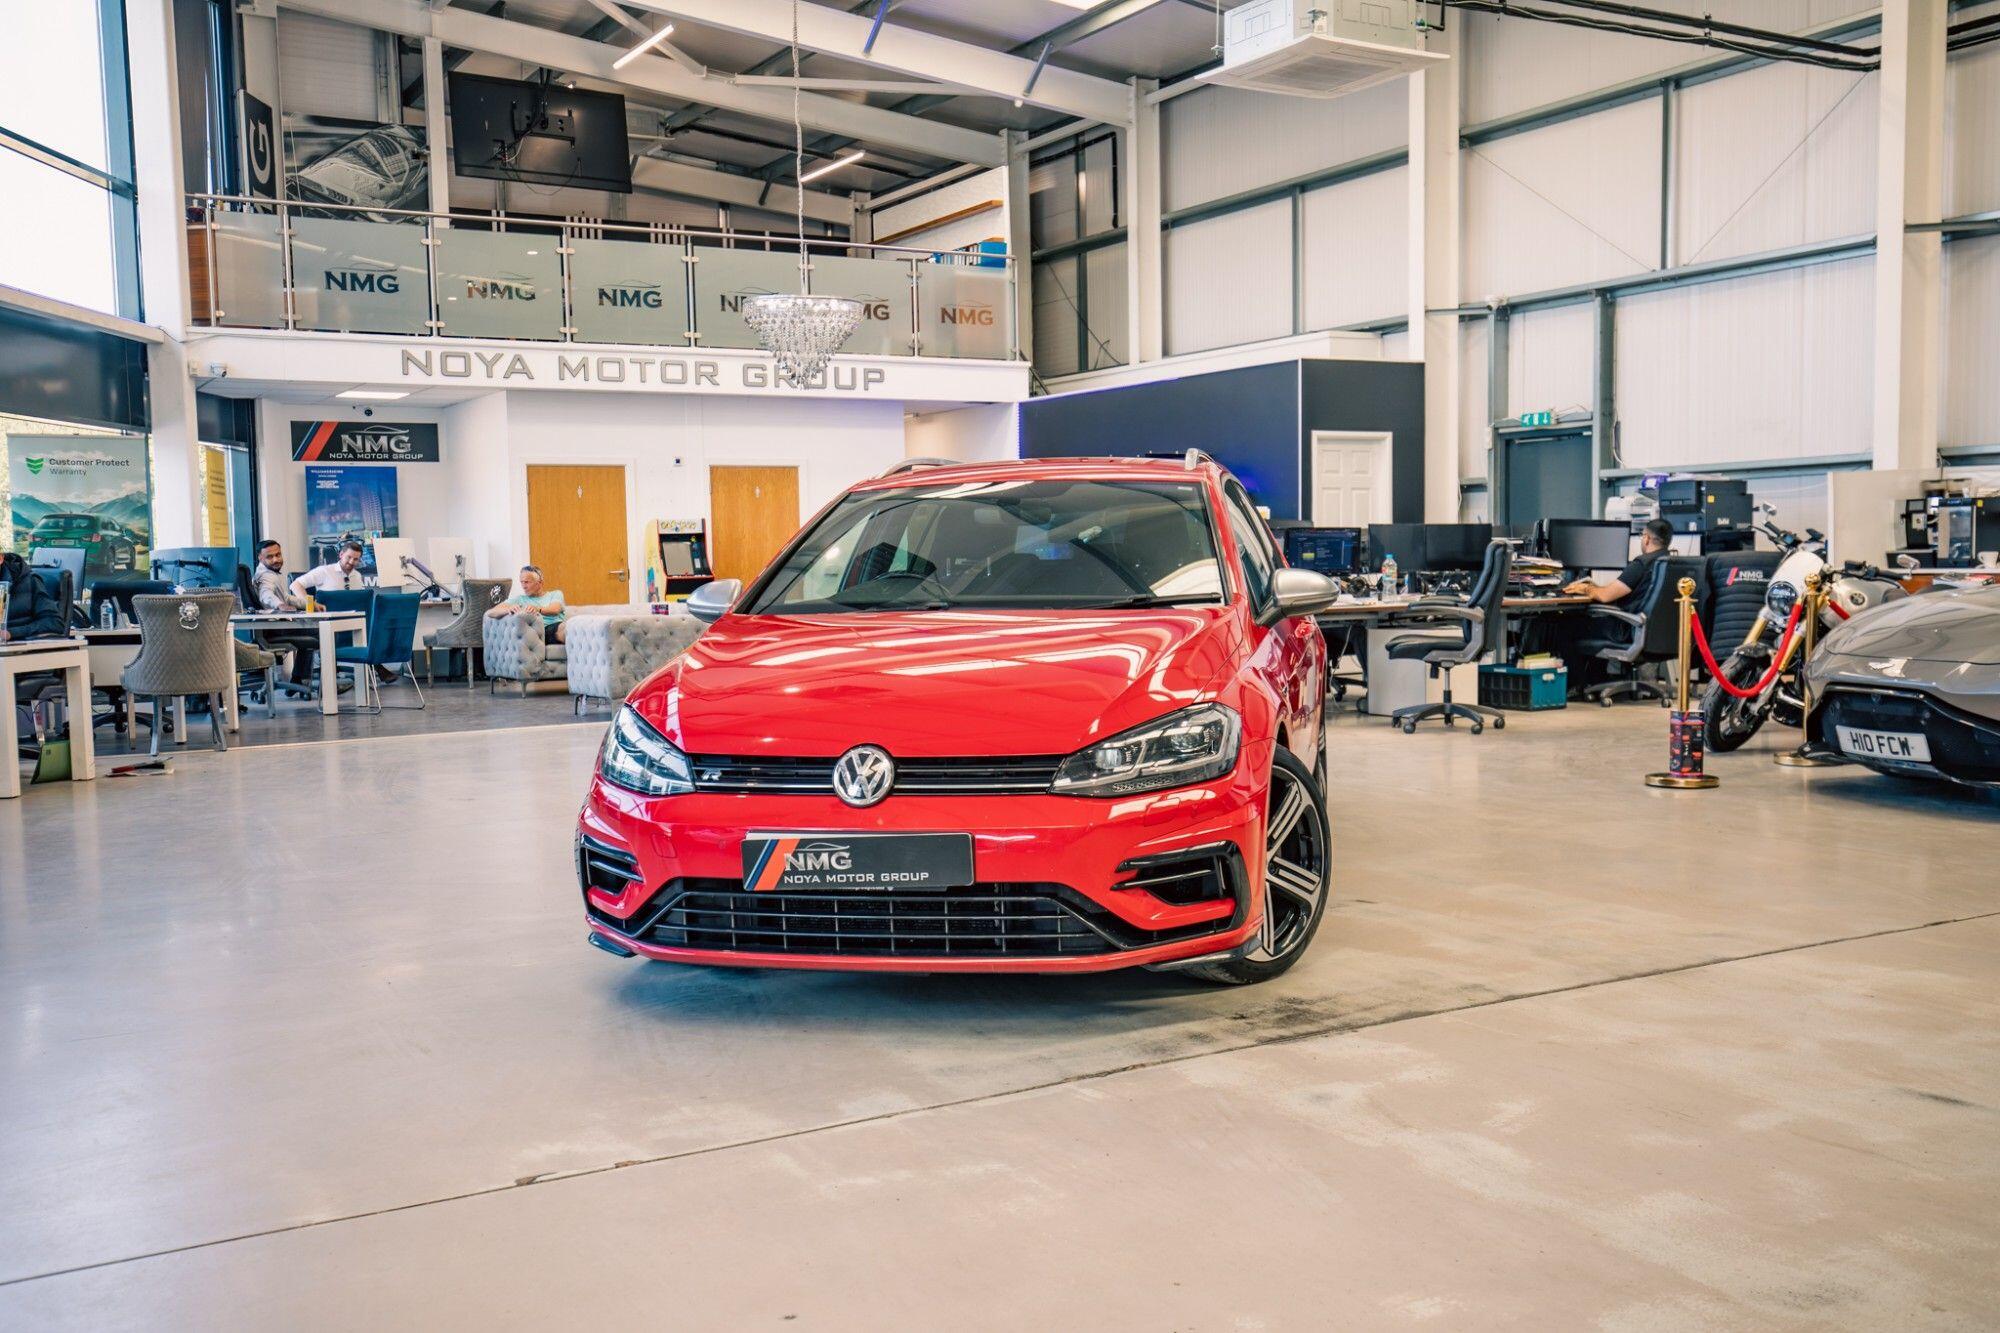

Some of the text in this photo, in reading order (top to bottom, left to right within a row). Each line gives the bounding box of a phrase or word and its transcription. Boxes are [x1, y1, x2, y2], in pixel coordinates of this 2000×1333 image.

[324, 271, 400, 294] NMG
[466, 279, 536, 301] NMG
[597, 287, 663, 308] NMG
[940, 307, 994, 326] NMG
[401, 349, 535, 380] NOYA
[558, 355, 721, 386] MOTOR
[341, 434, 411, 453] NMG
[49, 458, 130, 467] Customer Protect
[50, 468, 87, 476] Warranty
[1739, 570, 1764, 579] NMG
[1876, 735, 1911, 756] FCW
[784, 851, 852, 871] NMG
[784, 871, 929, 884] NOYA MOTOR GROUP
